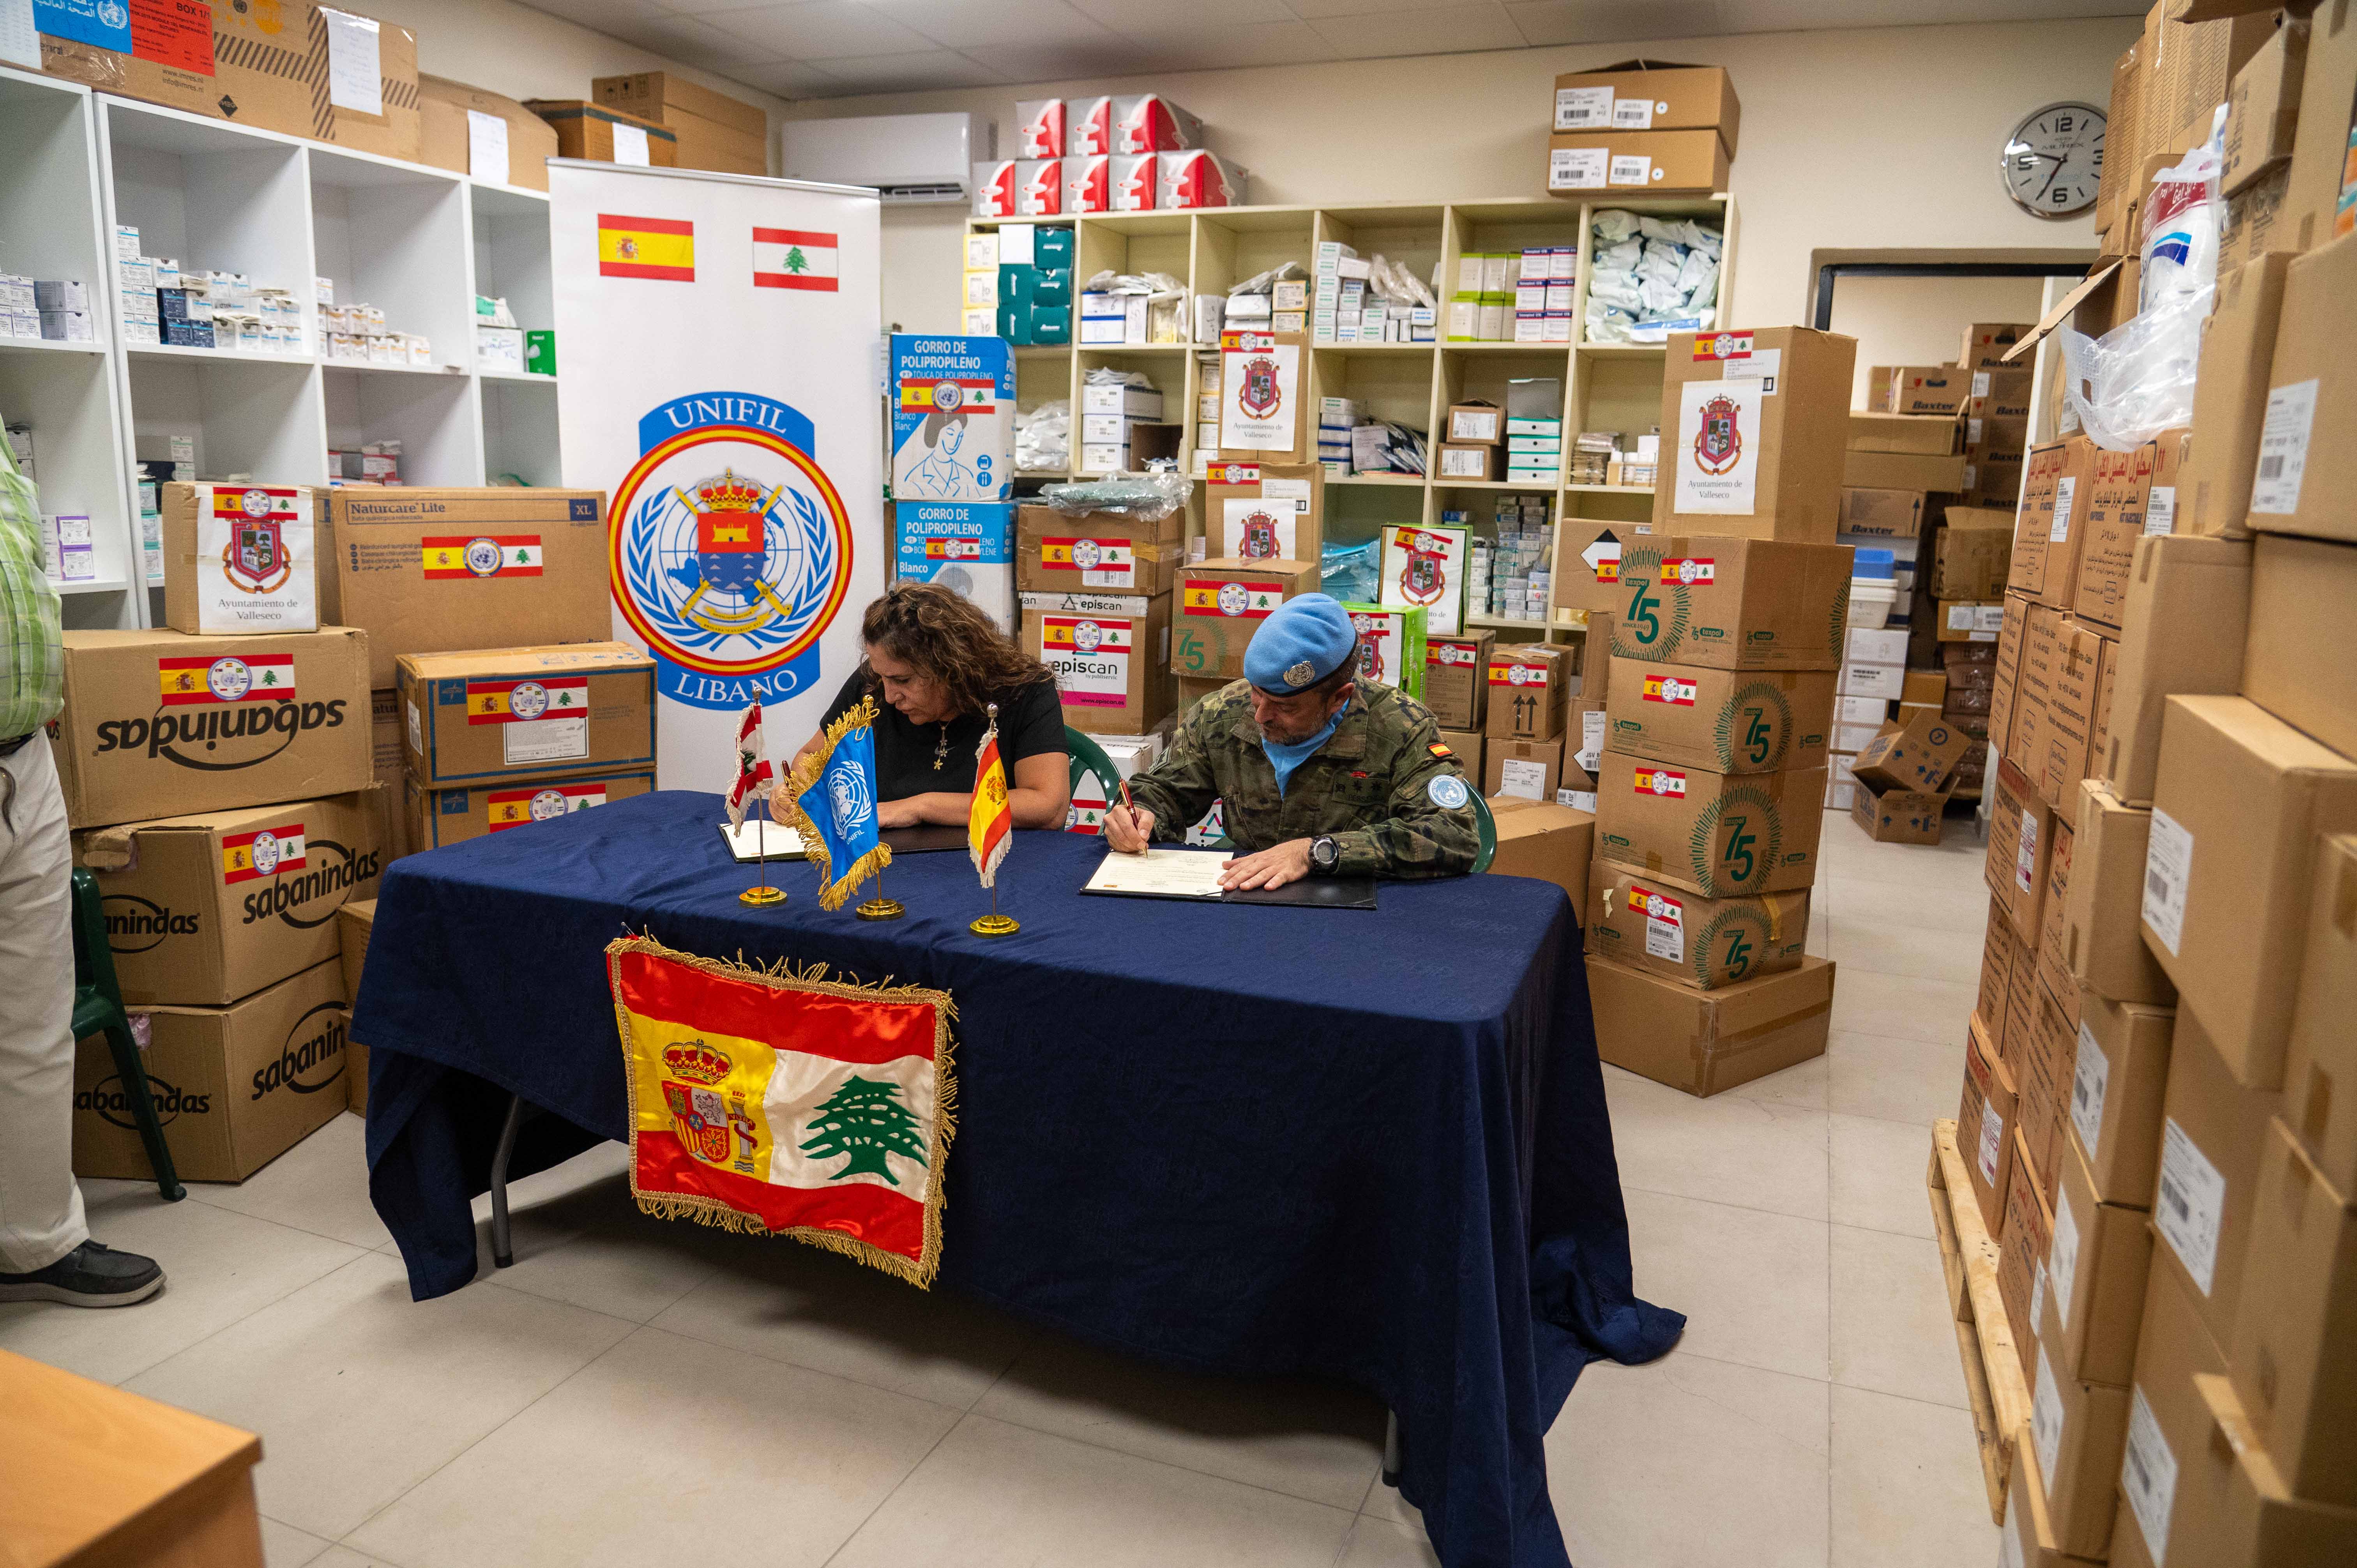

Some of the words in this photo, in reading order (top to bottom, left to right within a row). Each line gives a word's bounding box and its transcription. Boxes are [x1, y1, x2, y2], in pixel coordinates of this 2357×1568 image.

[176, 2, 196, 16] BOX
[199, 10, 210, 19] 1/1
[162, 69, 203, 83] www.imres.nl
[162, 77, 204, 93] info@imres.nl
[2055, 117, 2072, 133] 12
[2018, 156, 2033, 171] 9
[2052, 188, 2067, 203] 6
[914, 341, 950, 353] GORRO
[953, 342, 966, 353] DE
[901, 356, 981, 369] POLIPROPILENO
[1913, 400, 1956, 410] Baxter
[1996, 405, 2028, 415] Baxt
[664, 397, 787, 434] UNIFIL
[1233, 422, 1274, 431] Ayuntamiento
[1688, 480, 1733, 489] Ayuntamiento
[422, 503, 445, 513] Lite
[576, 505, 591, 515] XL
[919, 508, 954, 520] GORRO
[956, 509, 969, 520] DE
[906, 522, 982, 535] POLIPROPILENO
[1851, 524, 1895, 534] Baxter
[899, 562, 928, 573] Blanco
[219, 599, 284, 609] Ayuntamiento
[286, 599, 297, 607] de
[1081, 599, 1122, 611] episcan
[237, 611, 281, 620] Valleseco
[1626, 578, 1660, 645] 75
[1175, 629, 1205, 670] 75
[1053, 658, 1117, 675] episcan
[675, 670, 797, 702] LIBANO
[97, 700, 346, 758] sabanindas
[1622, 722, 1639, 730] texpol
[1744, 708, 1771, 764] 75
[846, 830, 865, 845] UNIFIL
[1611, 837, 1627, 846] texpol
[1724, 816, 1756, 881] 75
[243, 848, 379, 924] sabanindas
[105, 908, 198, 934] anindas
[1723, 929, 1753, 979] 75
[251, 1020, 345, 1101] sabanin
